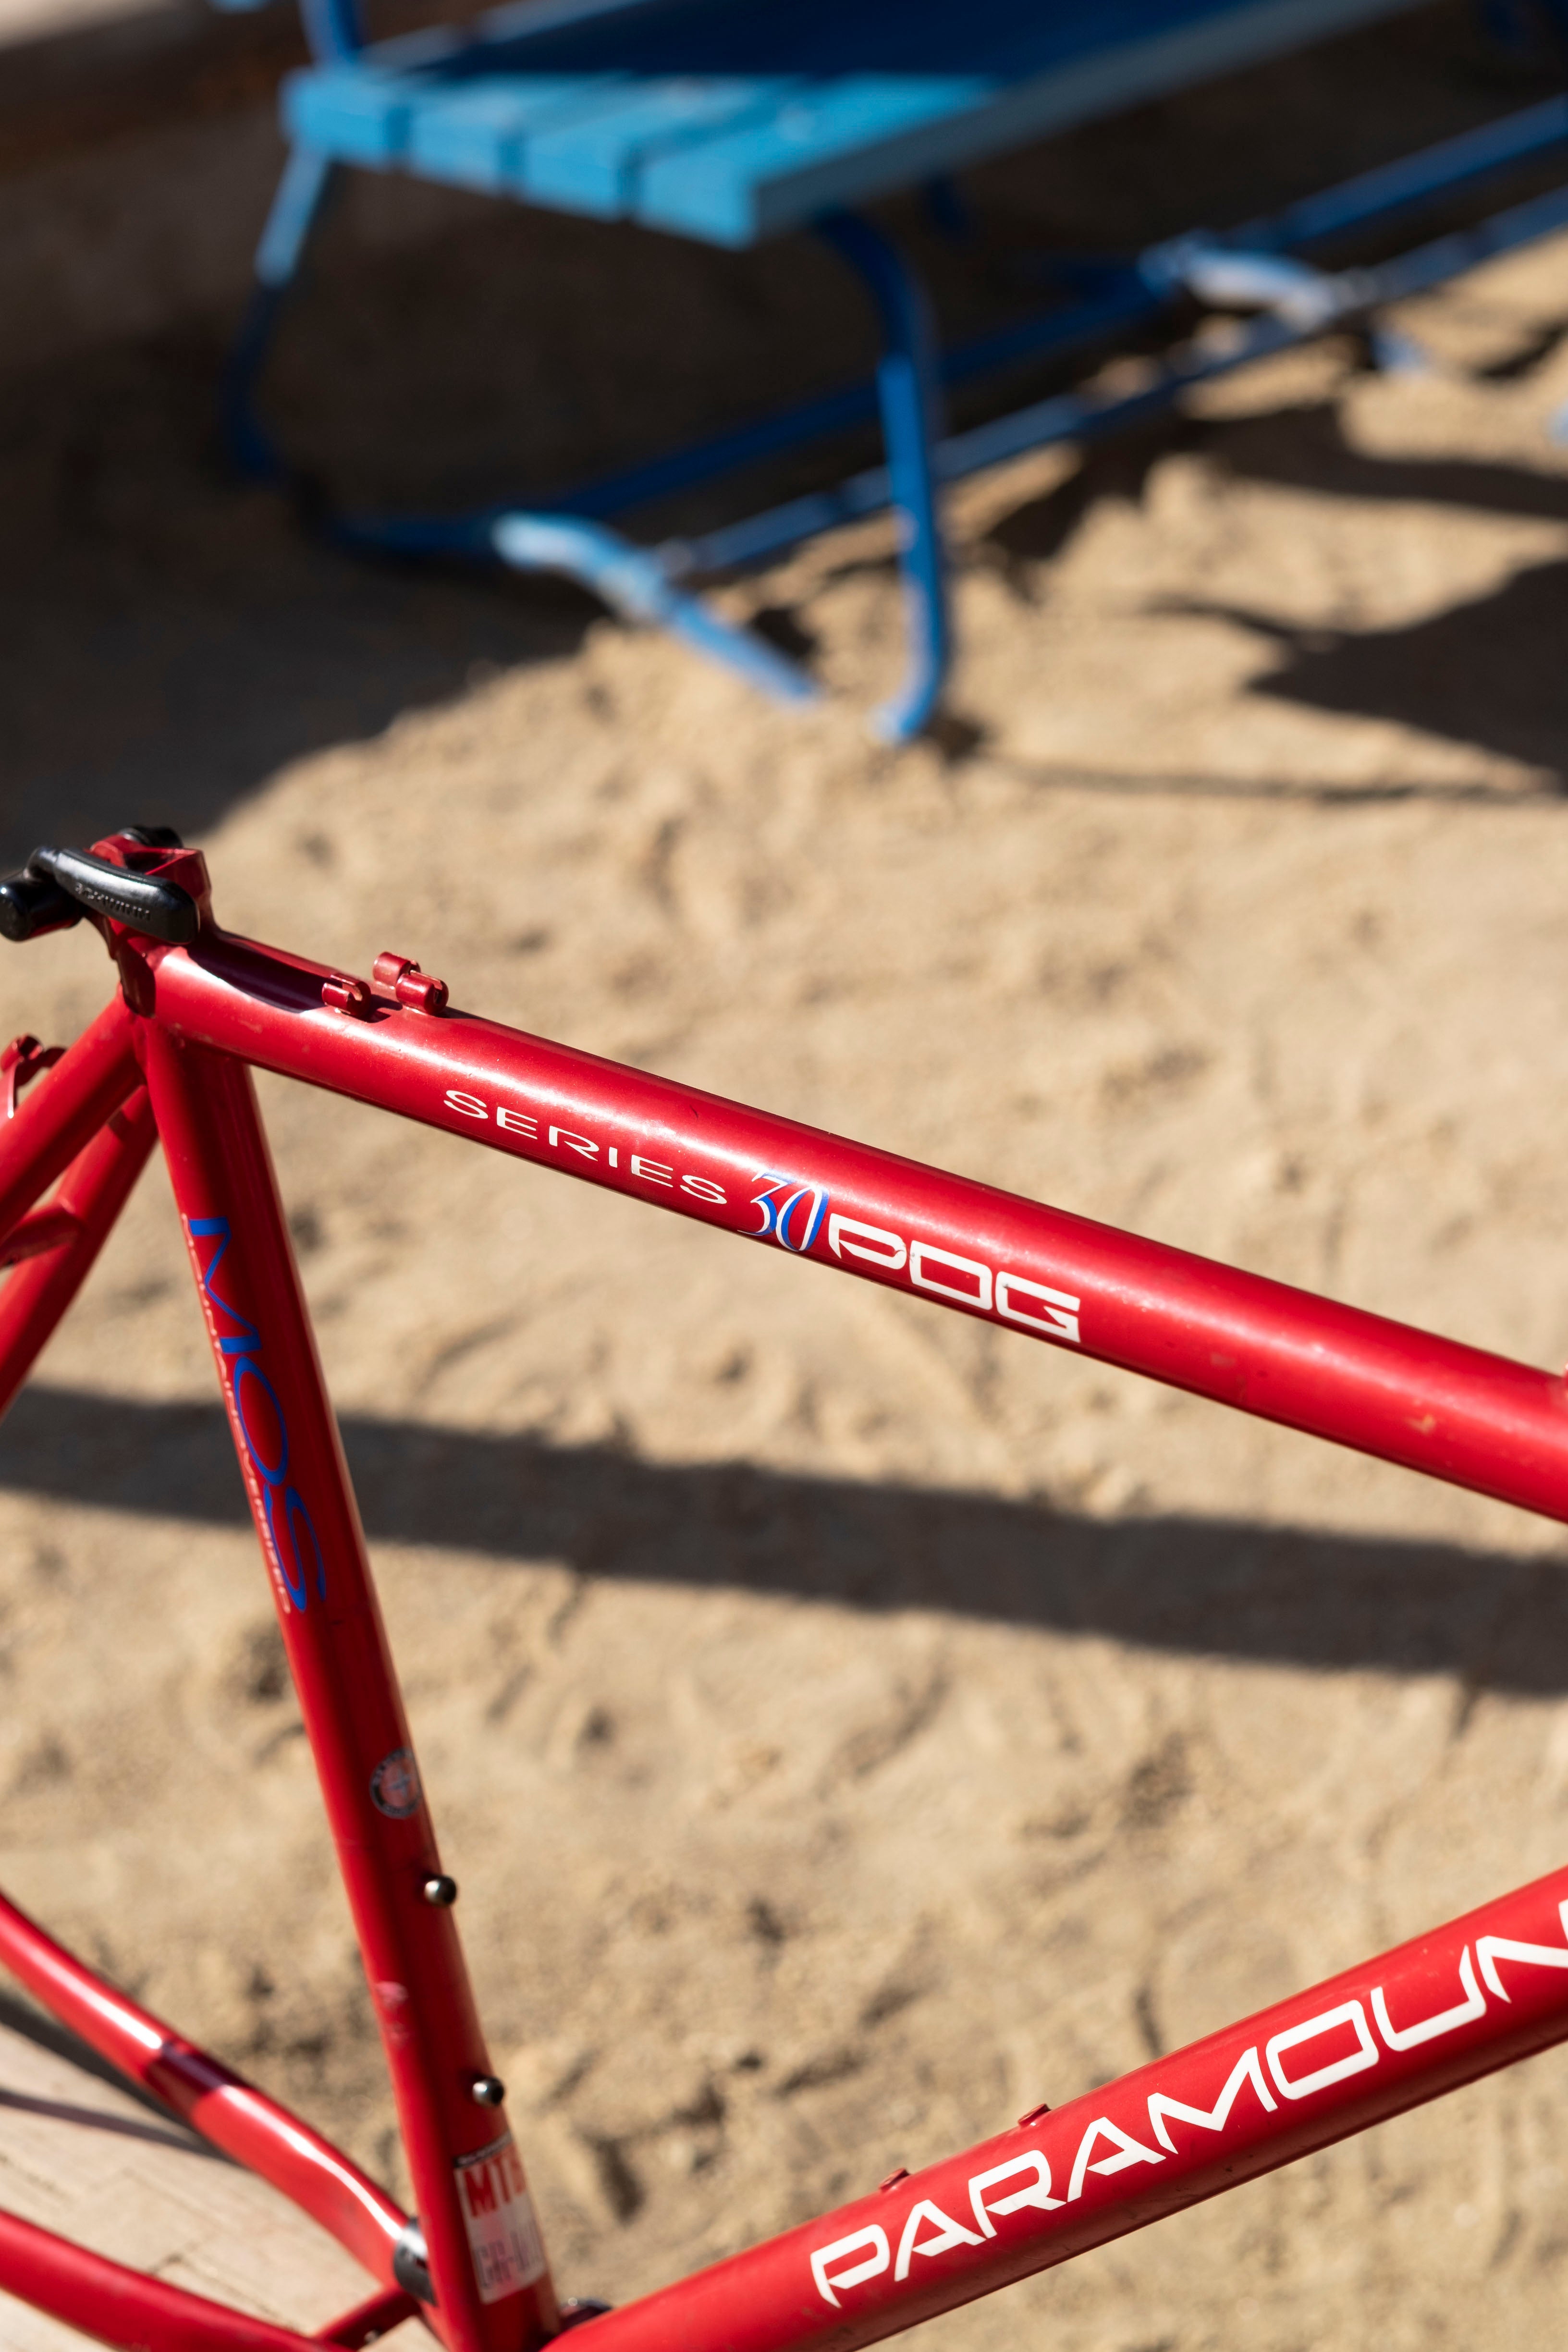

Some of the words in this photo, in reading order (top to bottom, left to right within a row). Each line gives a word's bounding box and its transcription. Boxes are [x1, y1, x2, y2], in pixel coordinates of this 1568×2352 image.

[443, 1090, 727, 1204] SERIES
[737, 1168, 830, 1252] 30
[189, 1216, 326, 1612] MOS
[809, 1898, 1568, 2307] PARAMOUN
